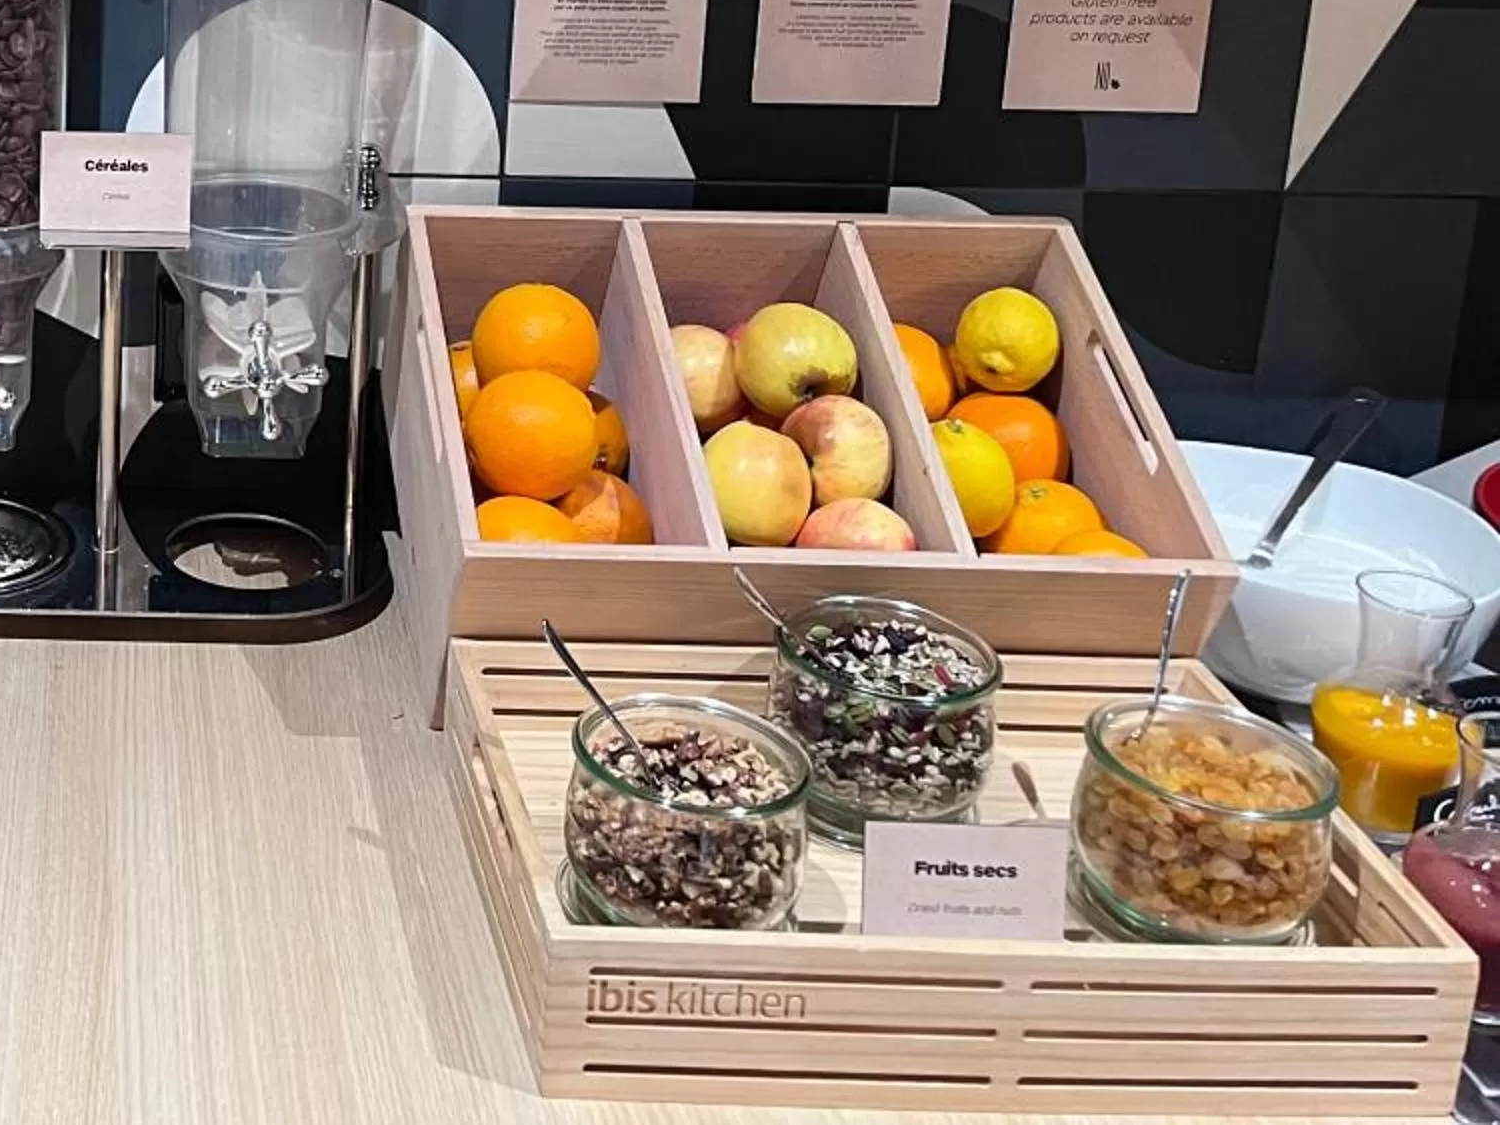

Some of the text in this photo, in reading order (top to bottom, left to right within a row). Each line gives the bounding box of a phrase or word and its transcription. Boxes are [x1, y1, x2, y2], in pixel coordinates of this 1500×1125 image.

[1029, 11, 1193, 27] products are available
[1069, 30, 1151, 45] on request
[85, 159, 149, 173] Céréales
[914, 860, 1018, 879] Fruits secs
[586, 978, 806, 1019] ibis kitchen
